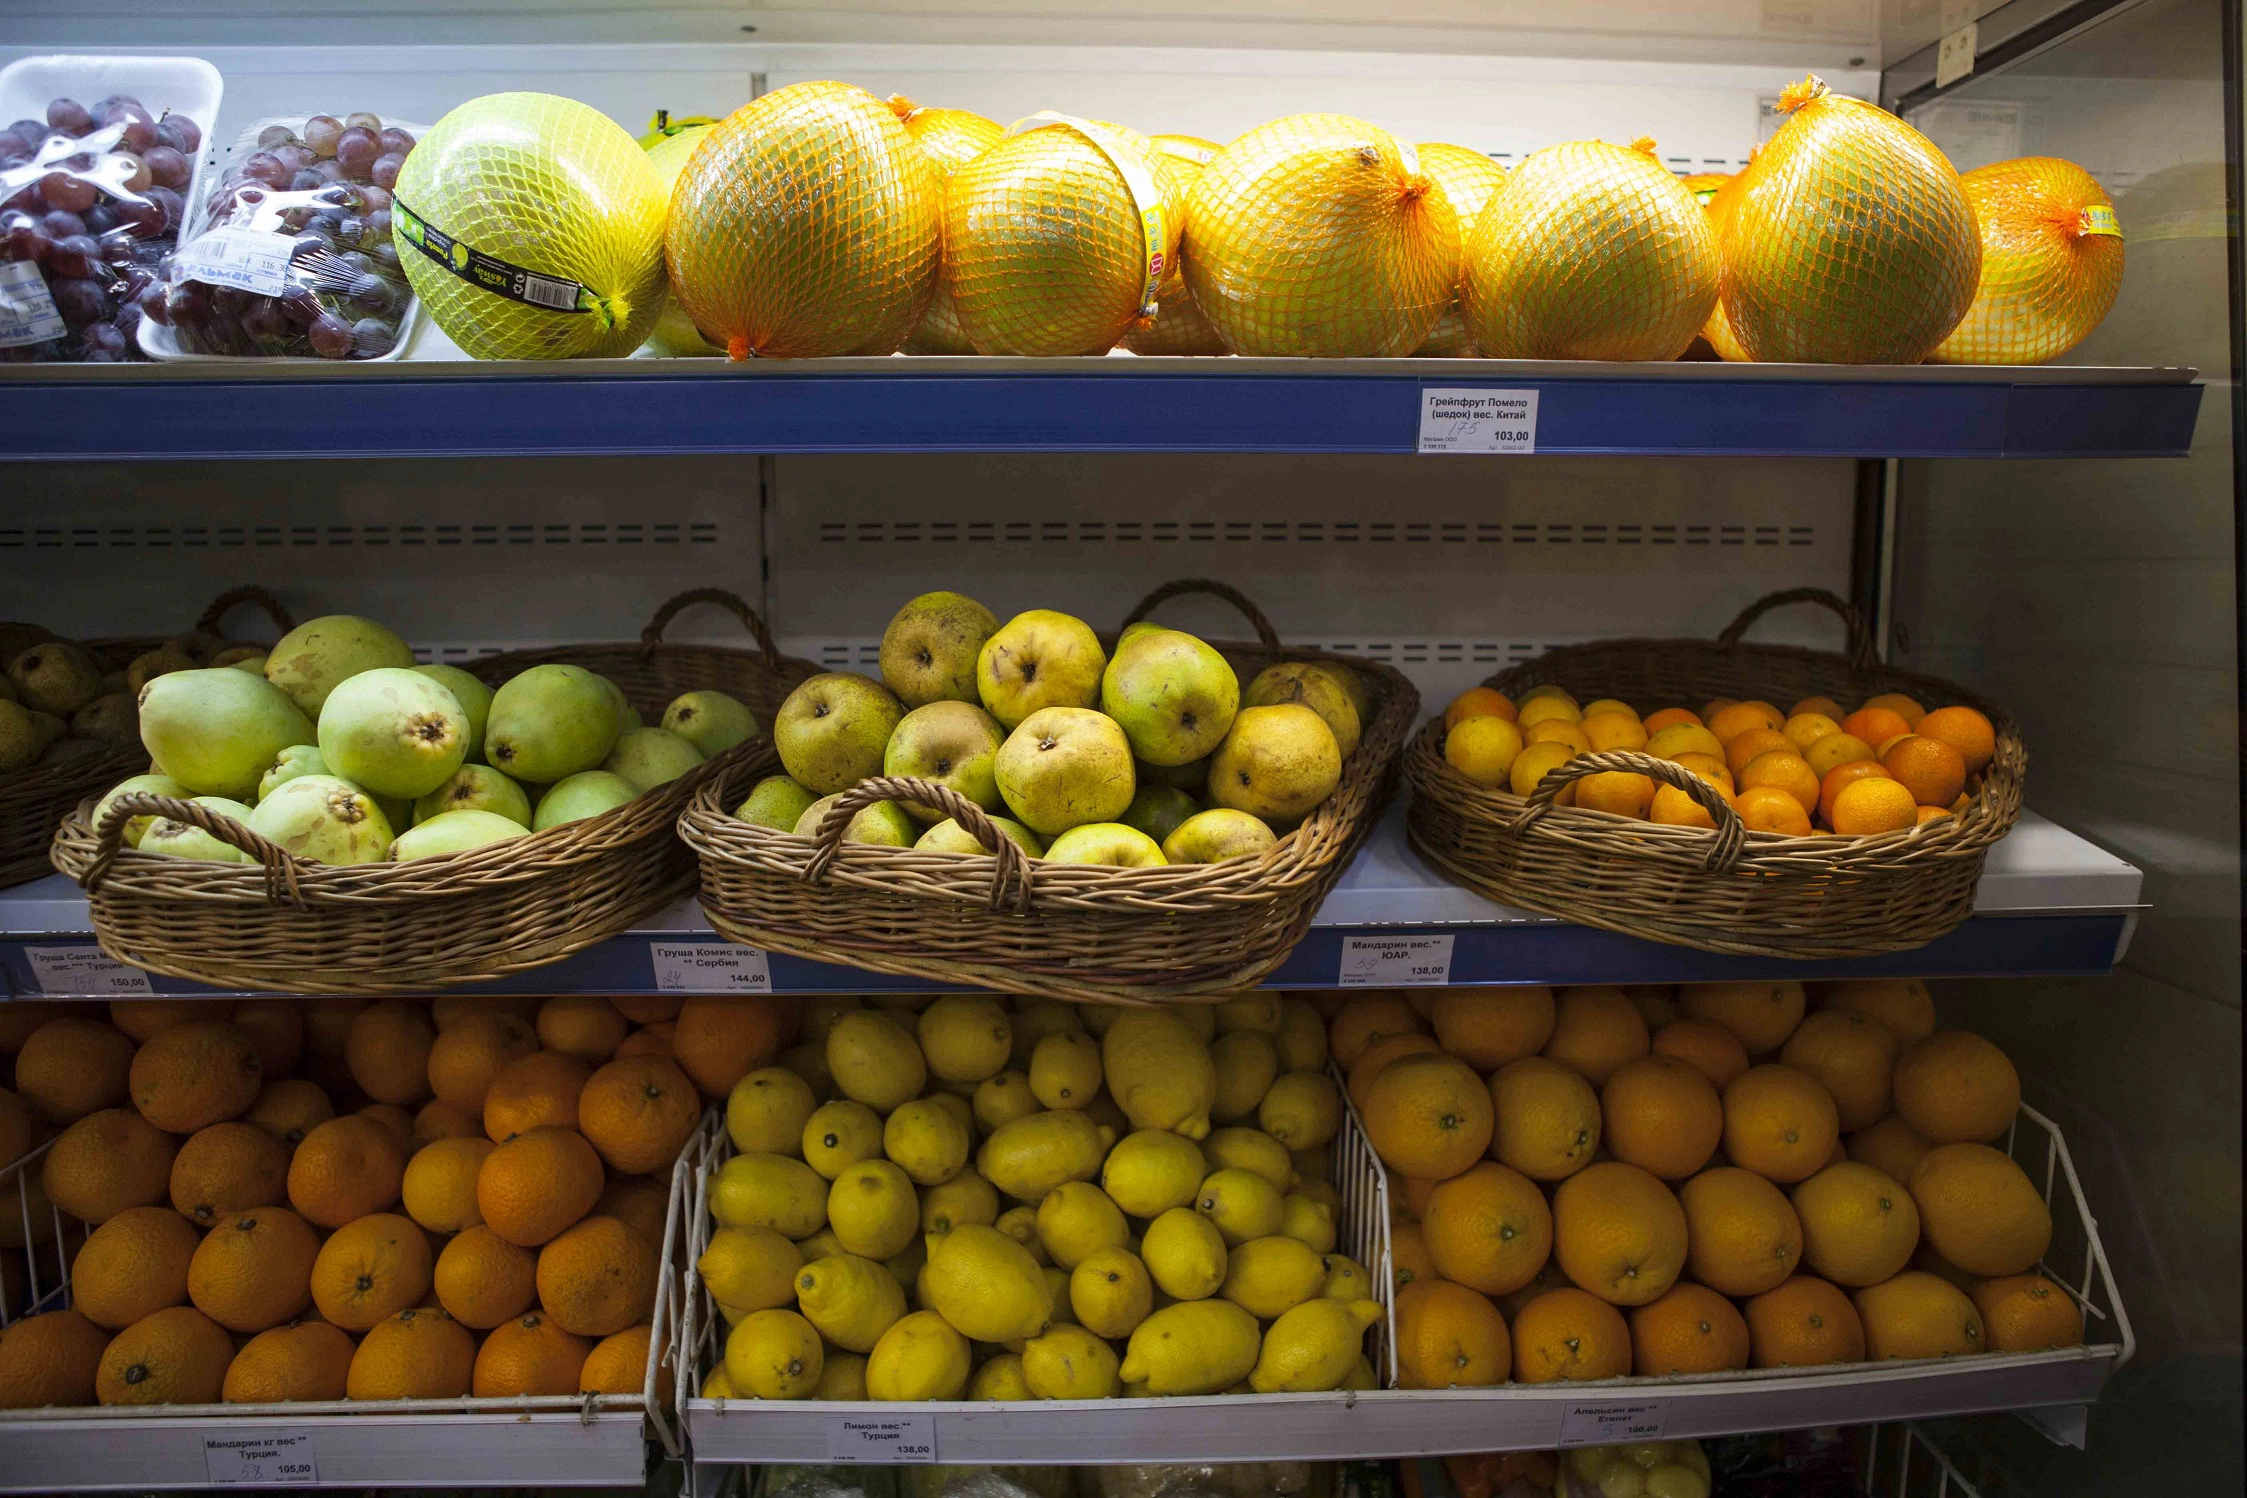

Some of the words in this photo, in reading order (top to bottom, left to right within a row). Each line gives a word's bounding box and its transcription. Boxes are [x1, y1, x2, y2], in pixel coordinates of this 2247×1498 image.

[1430, 397, 1486, 409] Грейпфрут
[1488, 398, 1528, 408] Помело
[1432, 410, 1471, 420] (шедок)
[1473, 411, 1494, 419] вес.
[1496, 410, 1526, 419] Китай
[1448, 421, 1480, 435] 175
[1494, 431, 1529, 443] 103,00
[1352, 941, 1407, 950] Мандарин
[33, 952, 65, 962] Груша
[66, 952, 97, 961] Санта
[657, 948, 693, 959] Груша
[696, 948, 733, 957] Комис
[1382, 951, 1411, 960] ЮАР.
[86, 962, 124, 971] Турция
[696, 959, 739, 968] Сербия
[1411, 966, 1444, 976] 138,00
[110, 978, 145, 988] 150,00
[730, 974, 765, 984] 144,00
[1574, 1407, 1625, 1415] Апельсин
[1598, 1415, 1632, 1423] Египет
[844, 1422, 878, 1430] Лимон
[1627, 1425, 1658, 1434] 100,00
[862, 1431, 900, 1440] Турция
[207, 1440, 261, 1449] Мандарин
[264, 1439, 273, 1447] кг
[897, 1445, 930, 1454] 138,00
[239, 1450, 281, 1460] Турция.
[278, 1464, 311, 1474] 105,00
